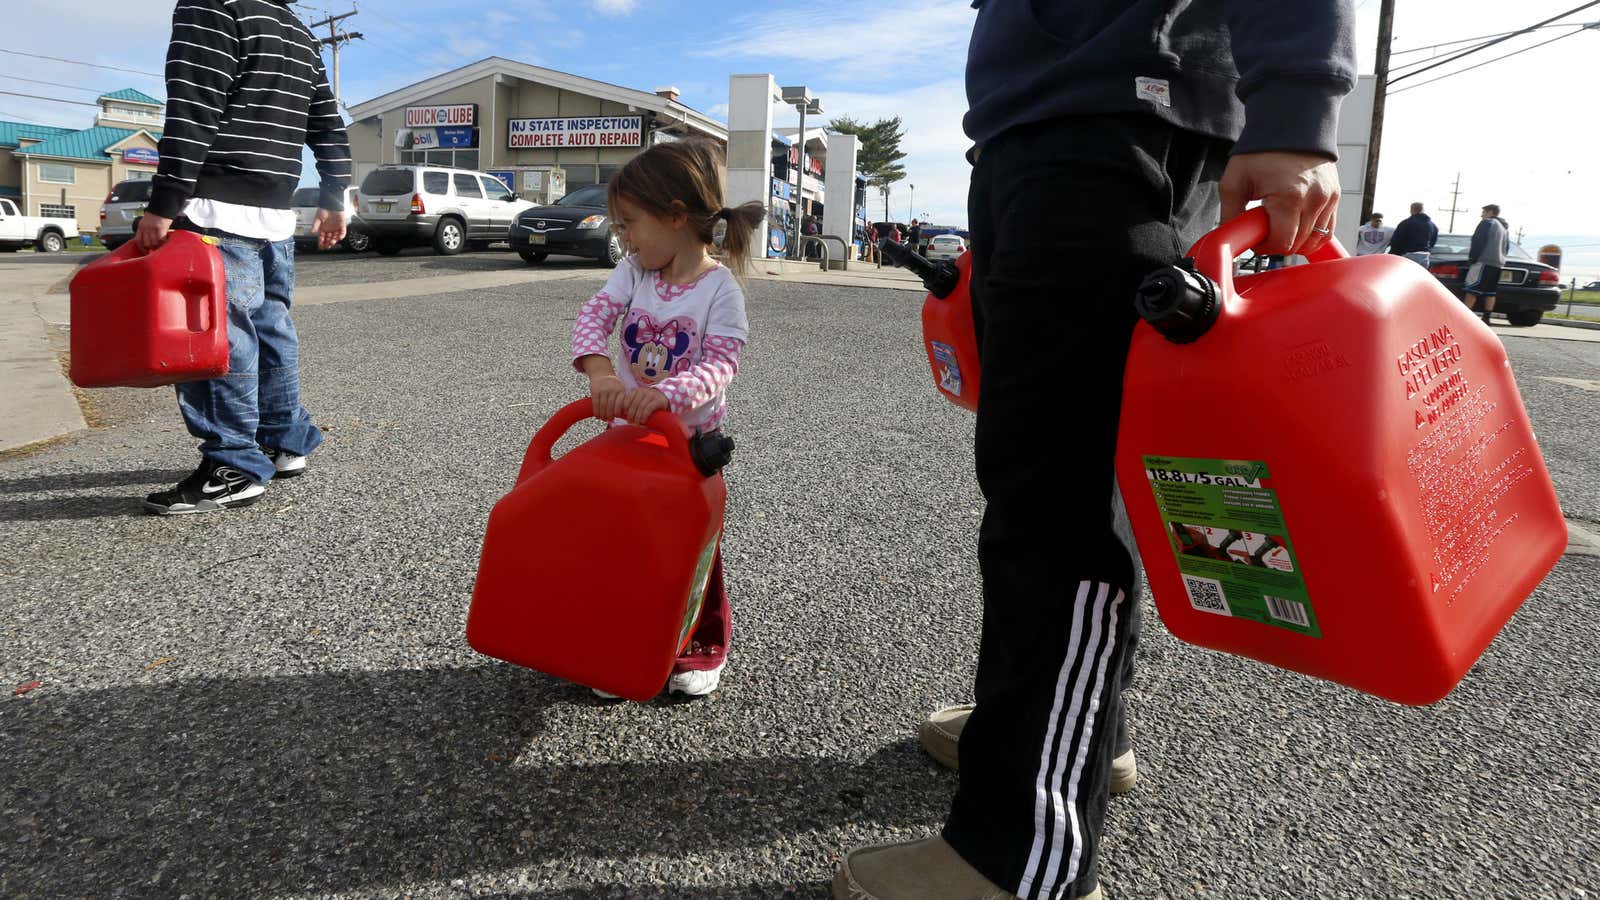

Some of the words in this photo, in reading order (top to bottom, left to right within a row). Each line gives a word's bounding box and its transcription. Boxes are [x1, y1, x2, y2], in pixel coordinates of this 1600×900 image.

[408, 108, 437, 125] QUICK
[447, 107, 472, 123] LUBE
[511, 121, 526, 132] NJ
[529, 120, 564, 132] STATE
[567, 118, 640, 130] INSPECTION
[412, 132, 433, 145] obil
[511, 134, 563, 146] COMPLETE
[568, 133, 596, 146] AUTO
[600, 132, 639, 145] REPAIR
[1397, 324, 1454, 376] GASOLINA
[1412, 342, 1461, 392] PELIGRO
[1205, 527, 1213, 536] 2
[1244, 532, 1252, 540] 3
